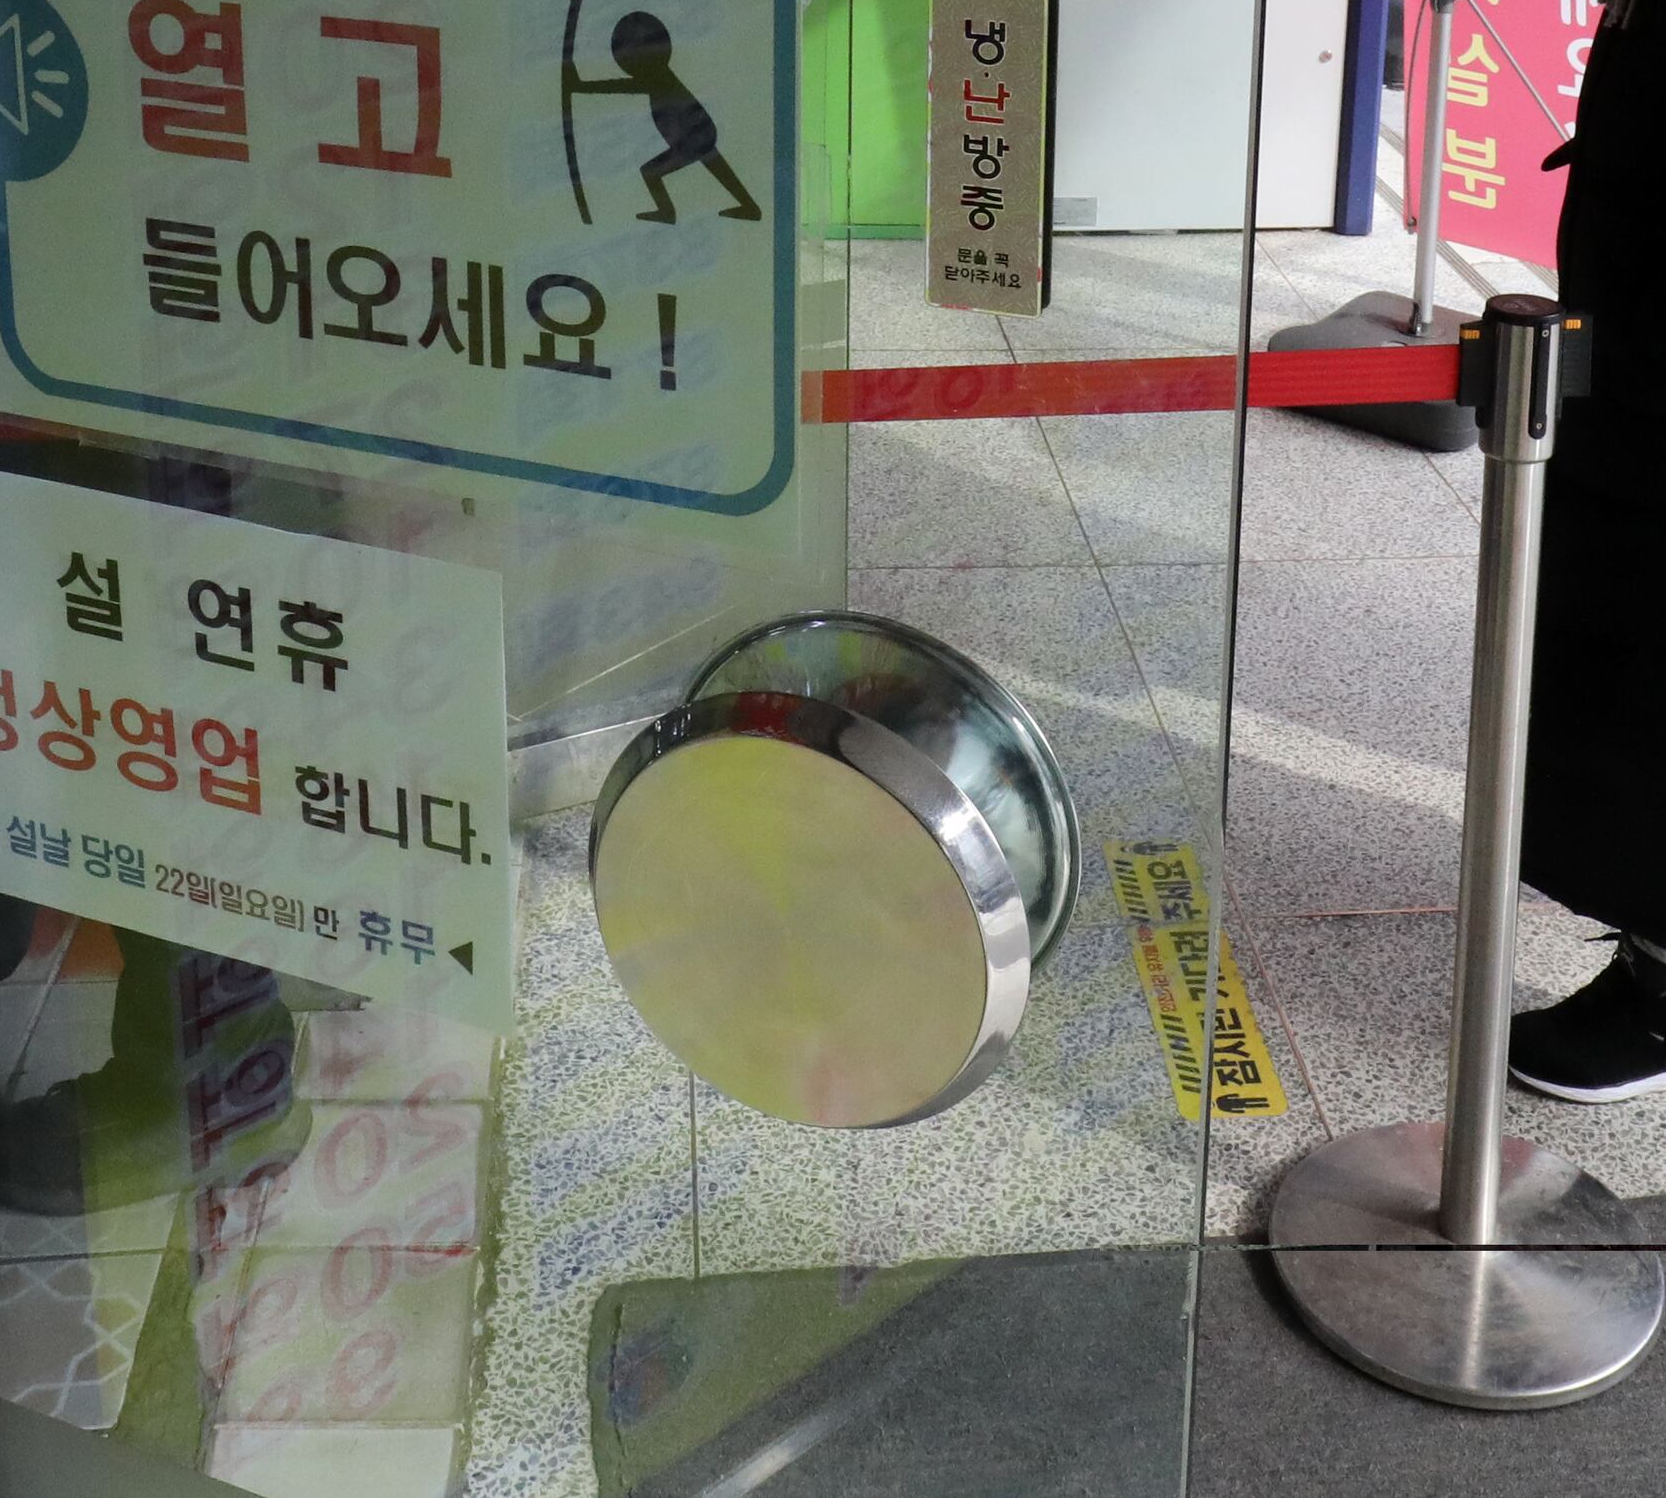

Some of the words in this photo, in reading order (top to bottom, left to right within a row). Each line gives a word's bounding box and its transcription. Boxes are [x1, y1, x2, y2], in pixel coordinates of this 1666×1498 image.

[944, 265, 1022, 288] 닫아주세요
[957, 248, 988, 265] 문을
[56, 551, 124, 642] 설
[187, 578, 349, 692] 연휴
[294, 765, 492, 865] 합니다.
[6, 815, 72, 869] 설날
[81, 834, 146, 889] 당일
[313, 905, 340, 941] 만
[358, 909, 436, 965] 휴무
